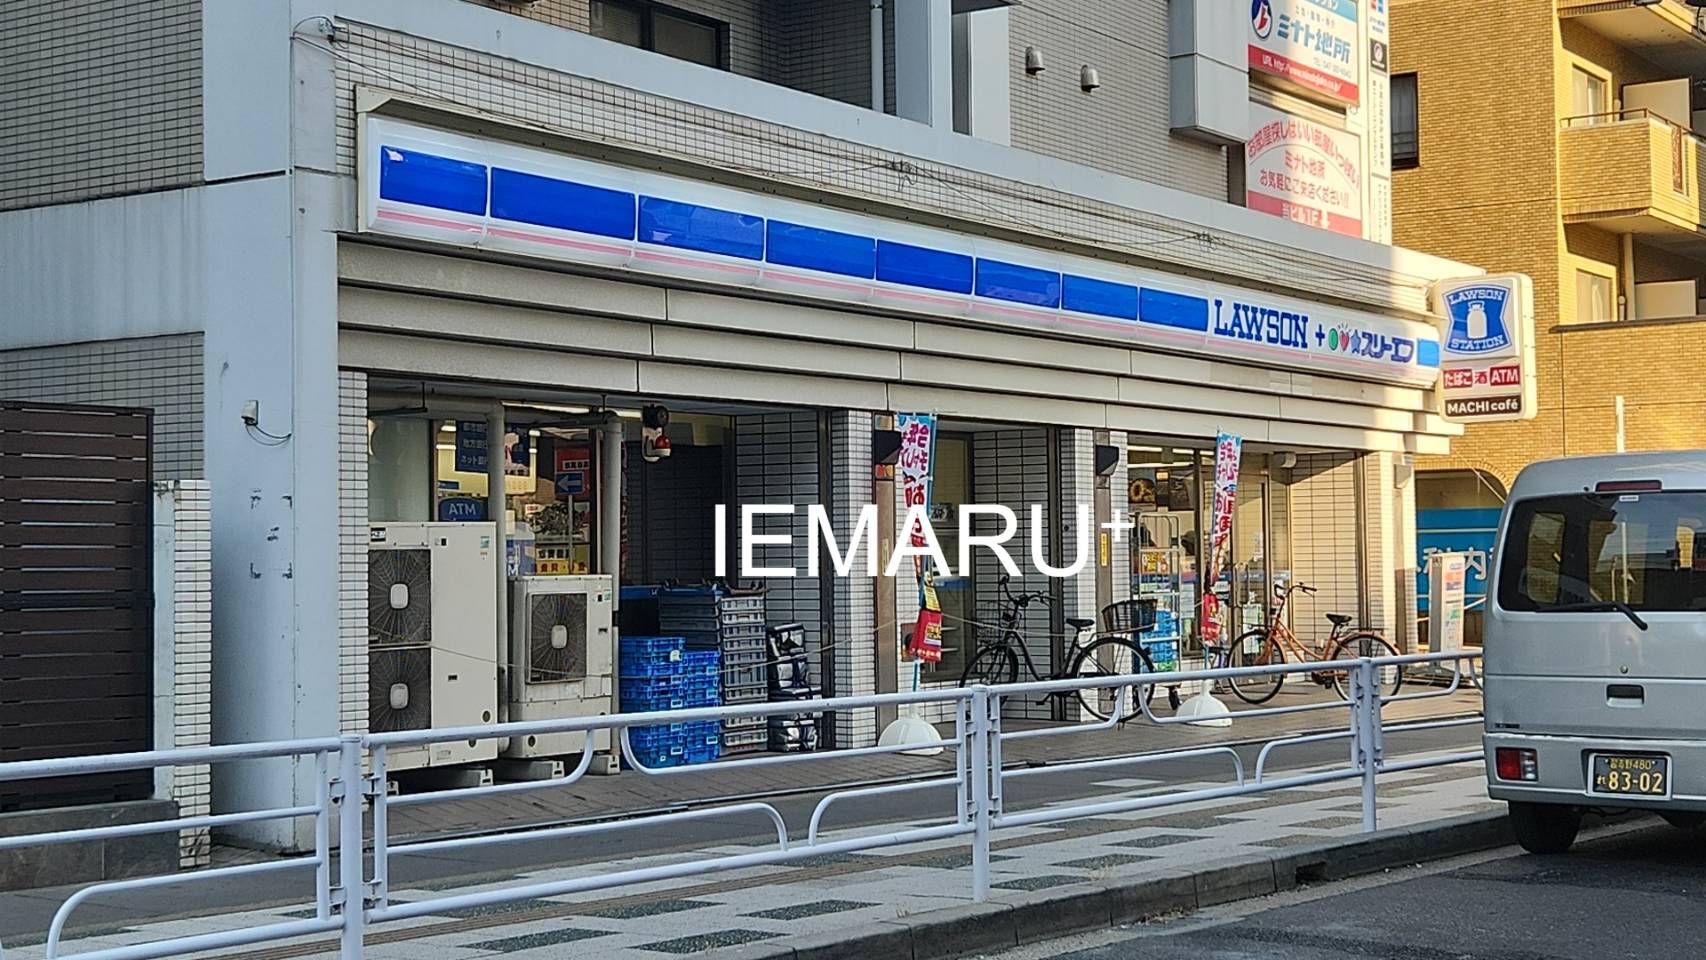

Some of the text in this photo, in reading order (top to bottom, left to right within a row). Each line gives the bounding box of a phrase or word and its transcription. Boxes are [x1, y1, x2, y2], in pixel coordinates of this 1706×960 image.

[1277, 14, 1352, 64] ミナト地所
[1448, 289, 1505, 305] LAWSON
[1214, 299, 1309, 349] LAWSON
[1450, 334, 1505, 350] STATION
[1444, 371, 1472, 387] たばこ
[1491, 369, 1519, 384] ATM
[1447, 398, 1519, 414] MACHI café
[448, 503, 477, 515] ATM
[1608, 771, 1663, 792] 83-02
